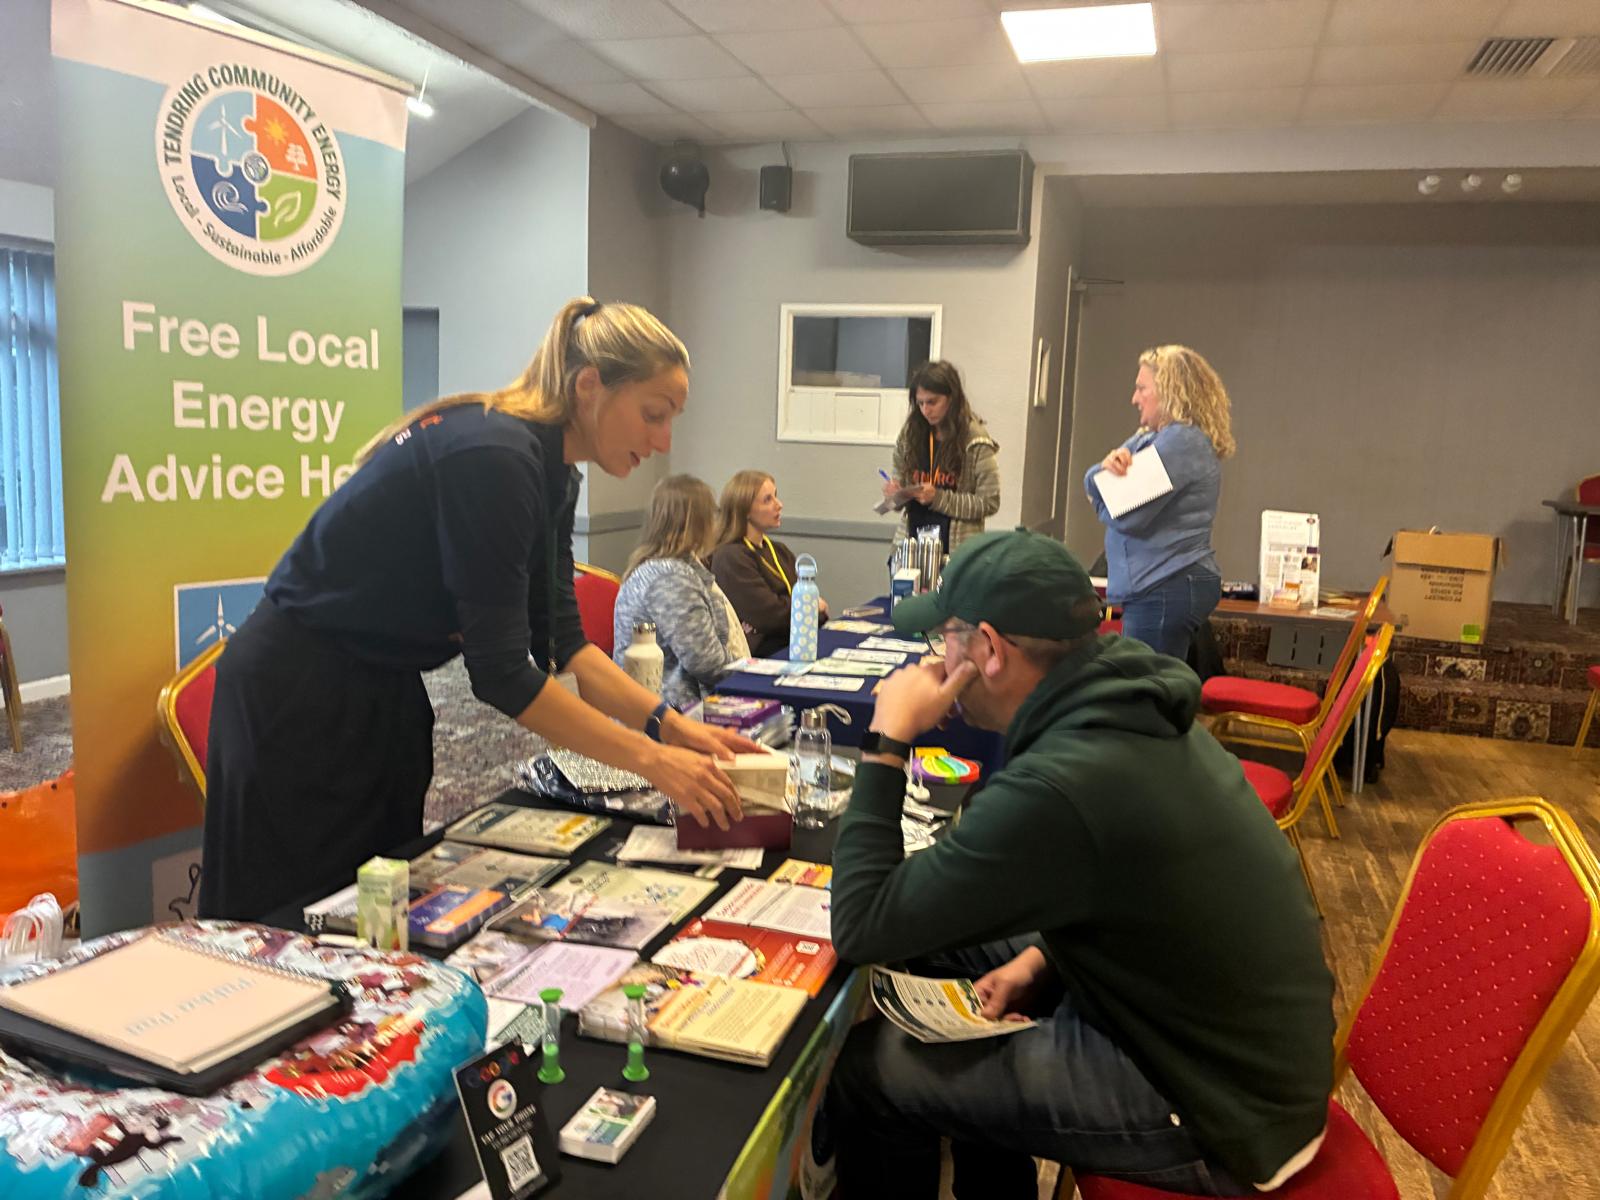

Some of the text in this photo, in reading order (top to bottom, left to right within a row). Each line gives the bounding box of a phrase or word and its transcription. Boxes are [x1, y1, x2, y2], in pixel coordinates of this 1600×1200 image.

[164, 63, 342, 202] TENDRING COMMUNITY ENERGY
[171, 174, 337, 265] Local Sustainable Affordable
[122, 300, 379, 370] Free Local
[172, 379, 345, 443] Energy
[101, 453, 354, 502] Advice He
